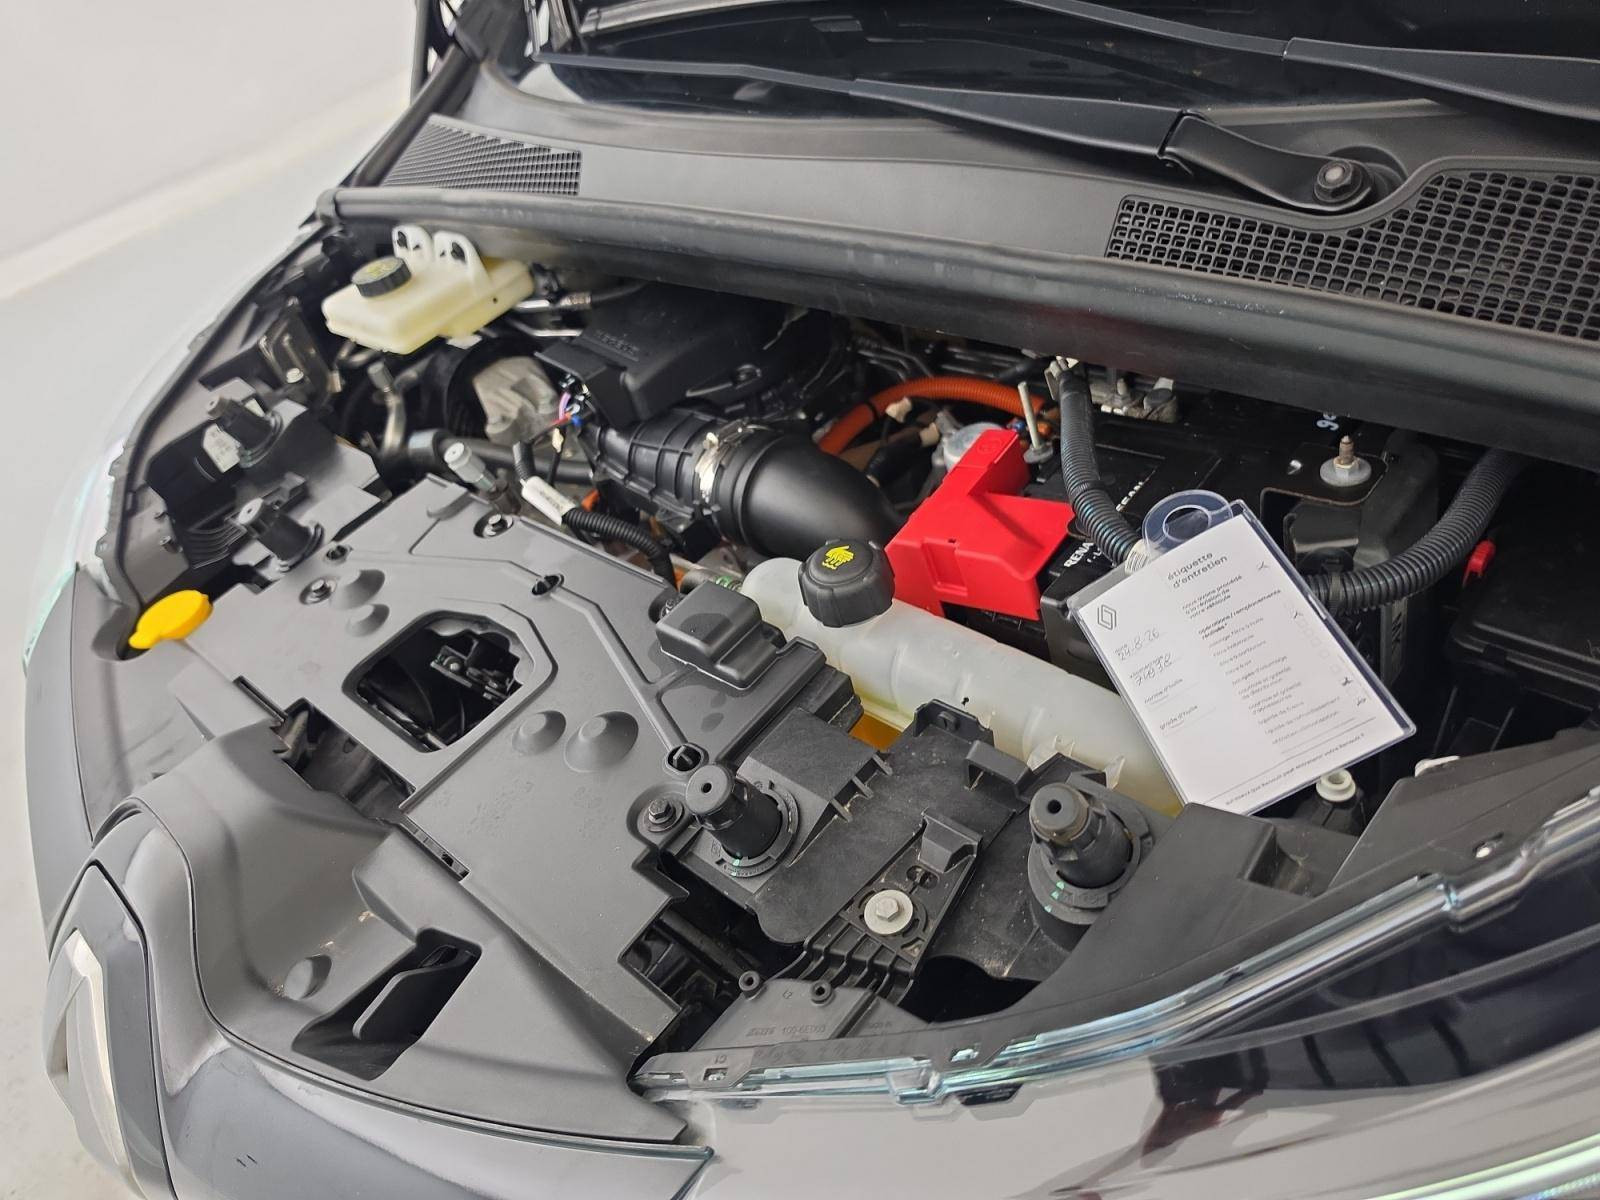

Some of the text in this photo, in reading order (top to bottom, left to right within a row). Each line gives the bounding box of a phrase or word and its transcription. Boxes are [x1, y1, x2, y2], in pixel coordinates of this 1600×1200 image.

[1063, 541, 1095, 568] RENA
[1167, 553, 1213, 580] étiquette
[1173, 556, 1227, 588] d'entretien
